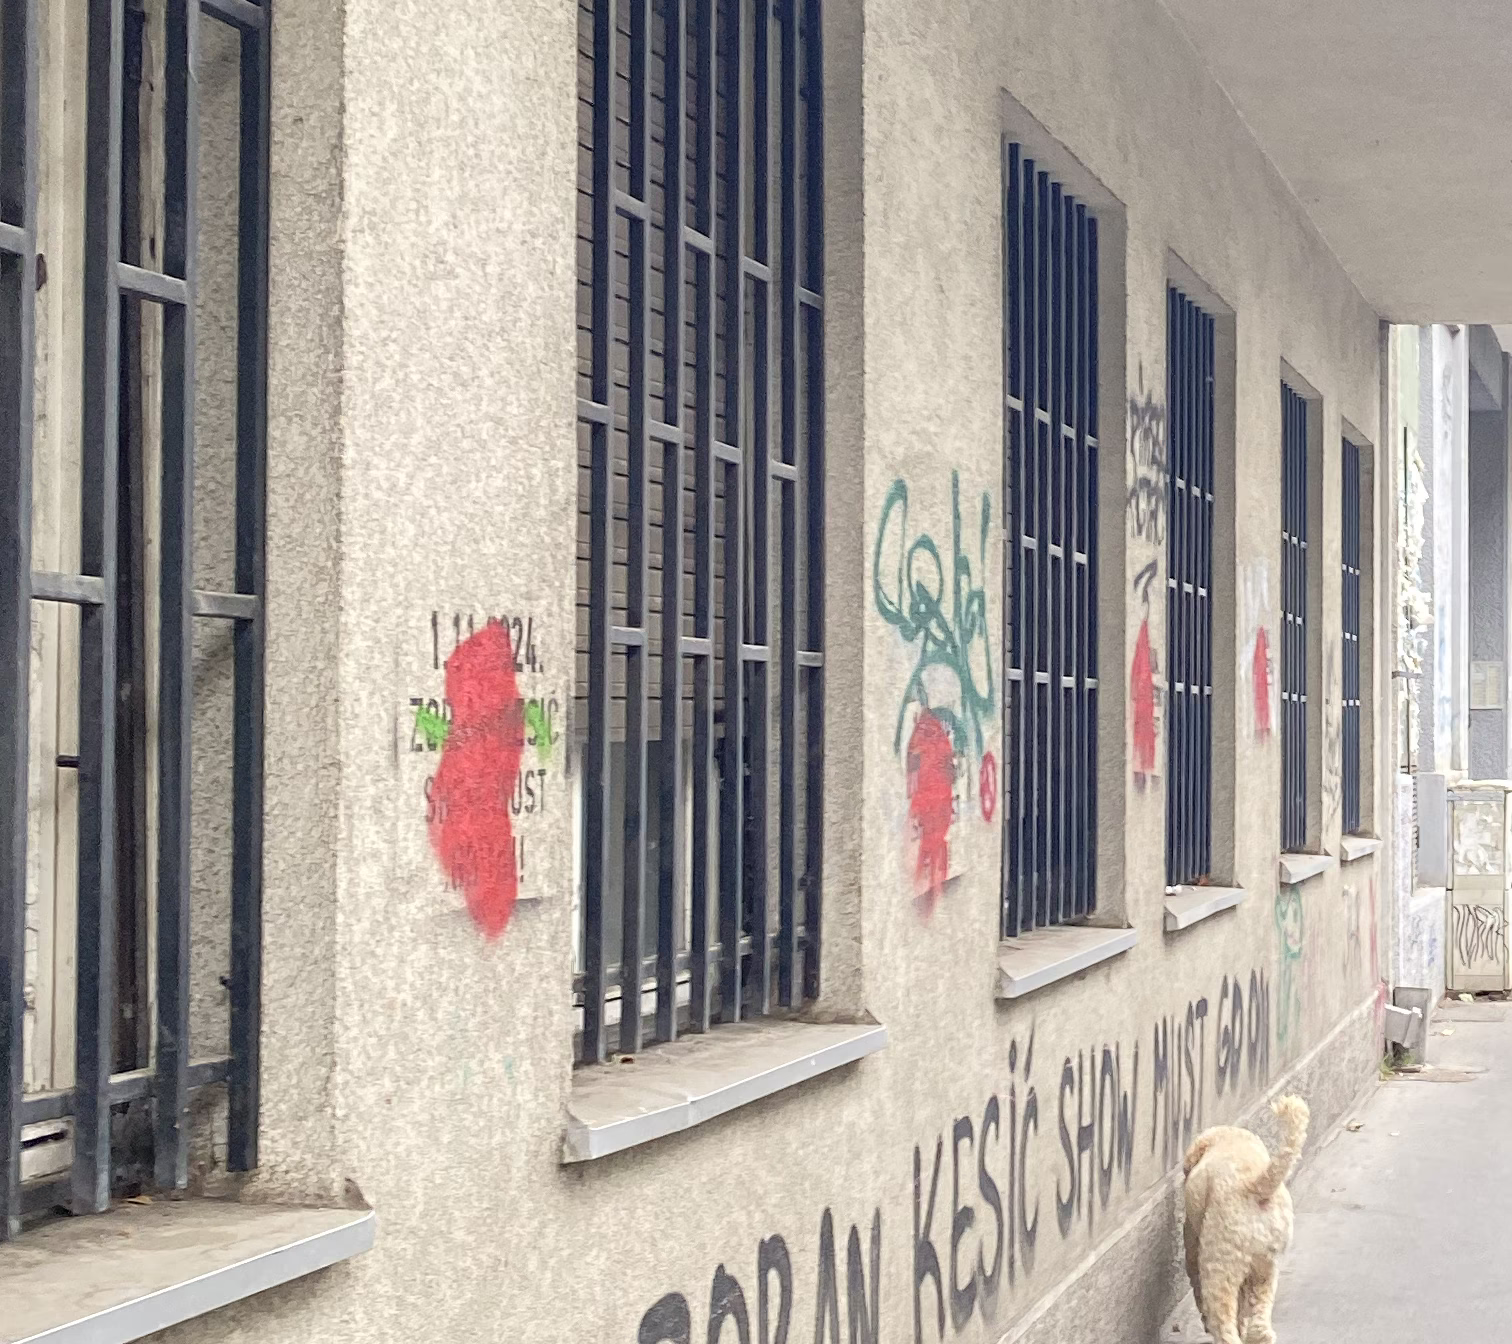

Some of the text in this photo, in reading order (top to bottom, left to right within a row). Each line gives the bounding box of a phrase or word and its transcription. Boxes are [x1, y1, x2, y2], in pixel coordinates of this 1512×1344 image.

[1056, 1040, 1139, 1240] SHOW
[1151, 996, 1208, 1171] MUST
[1214, 973, 1243, 1099] GO
[1247, 966, 1270, 1092] ON
